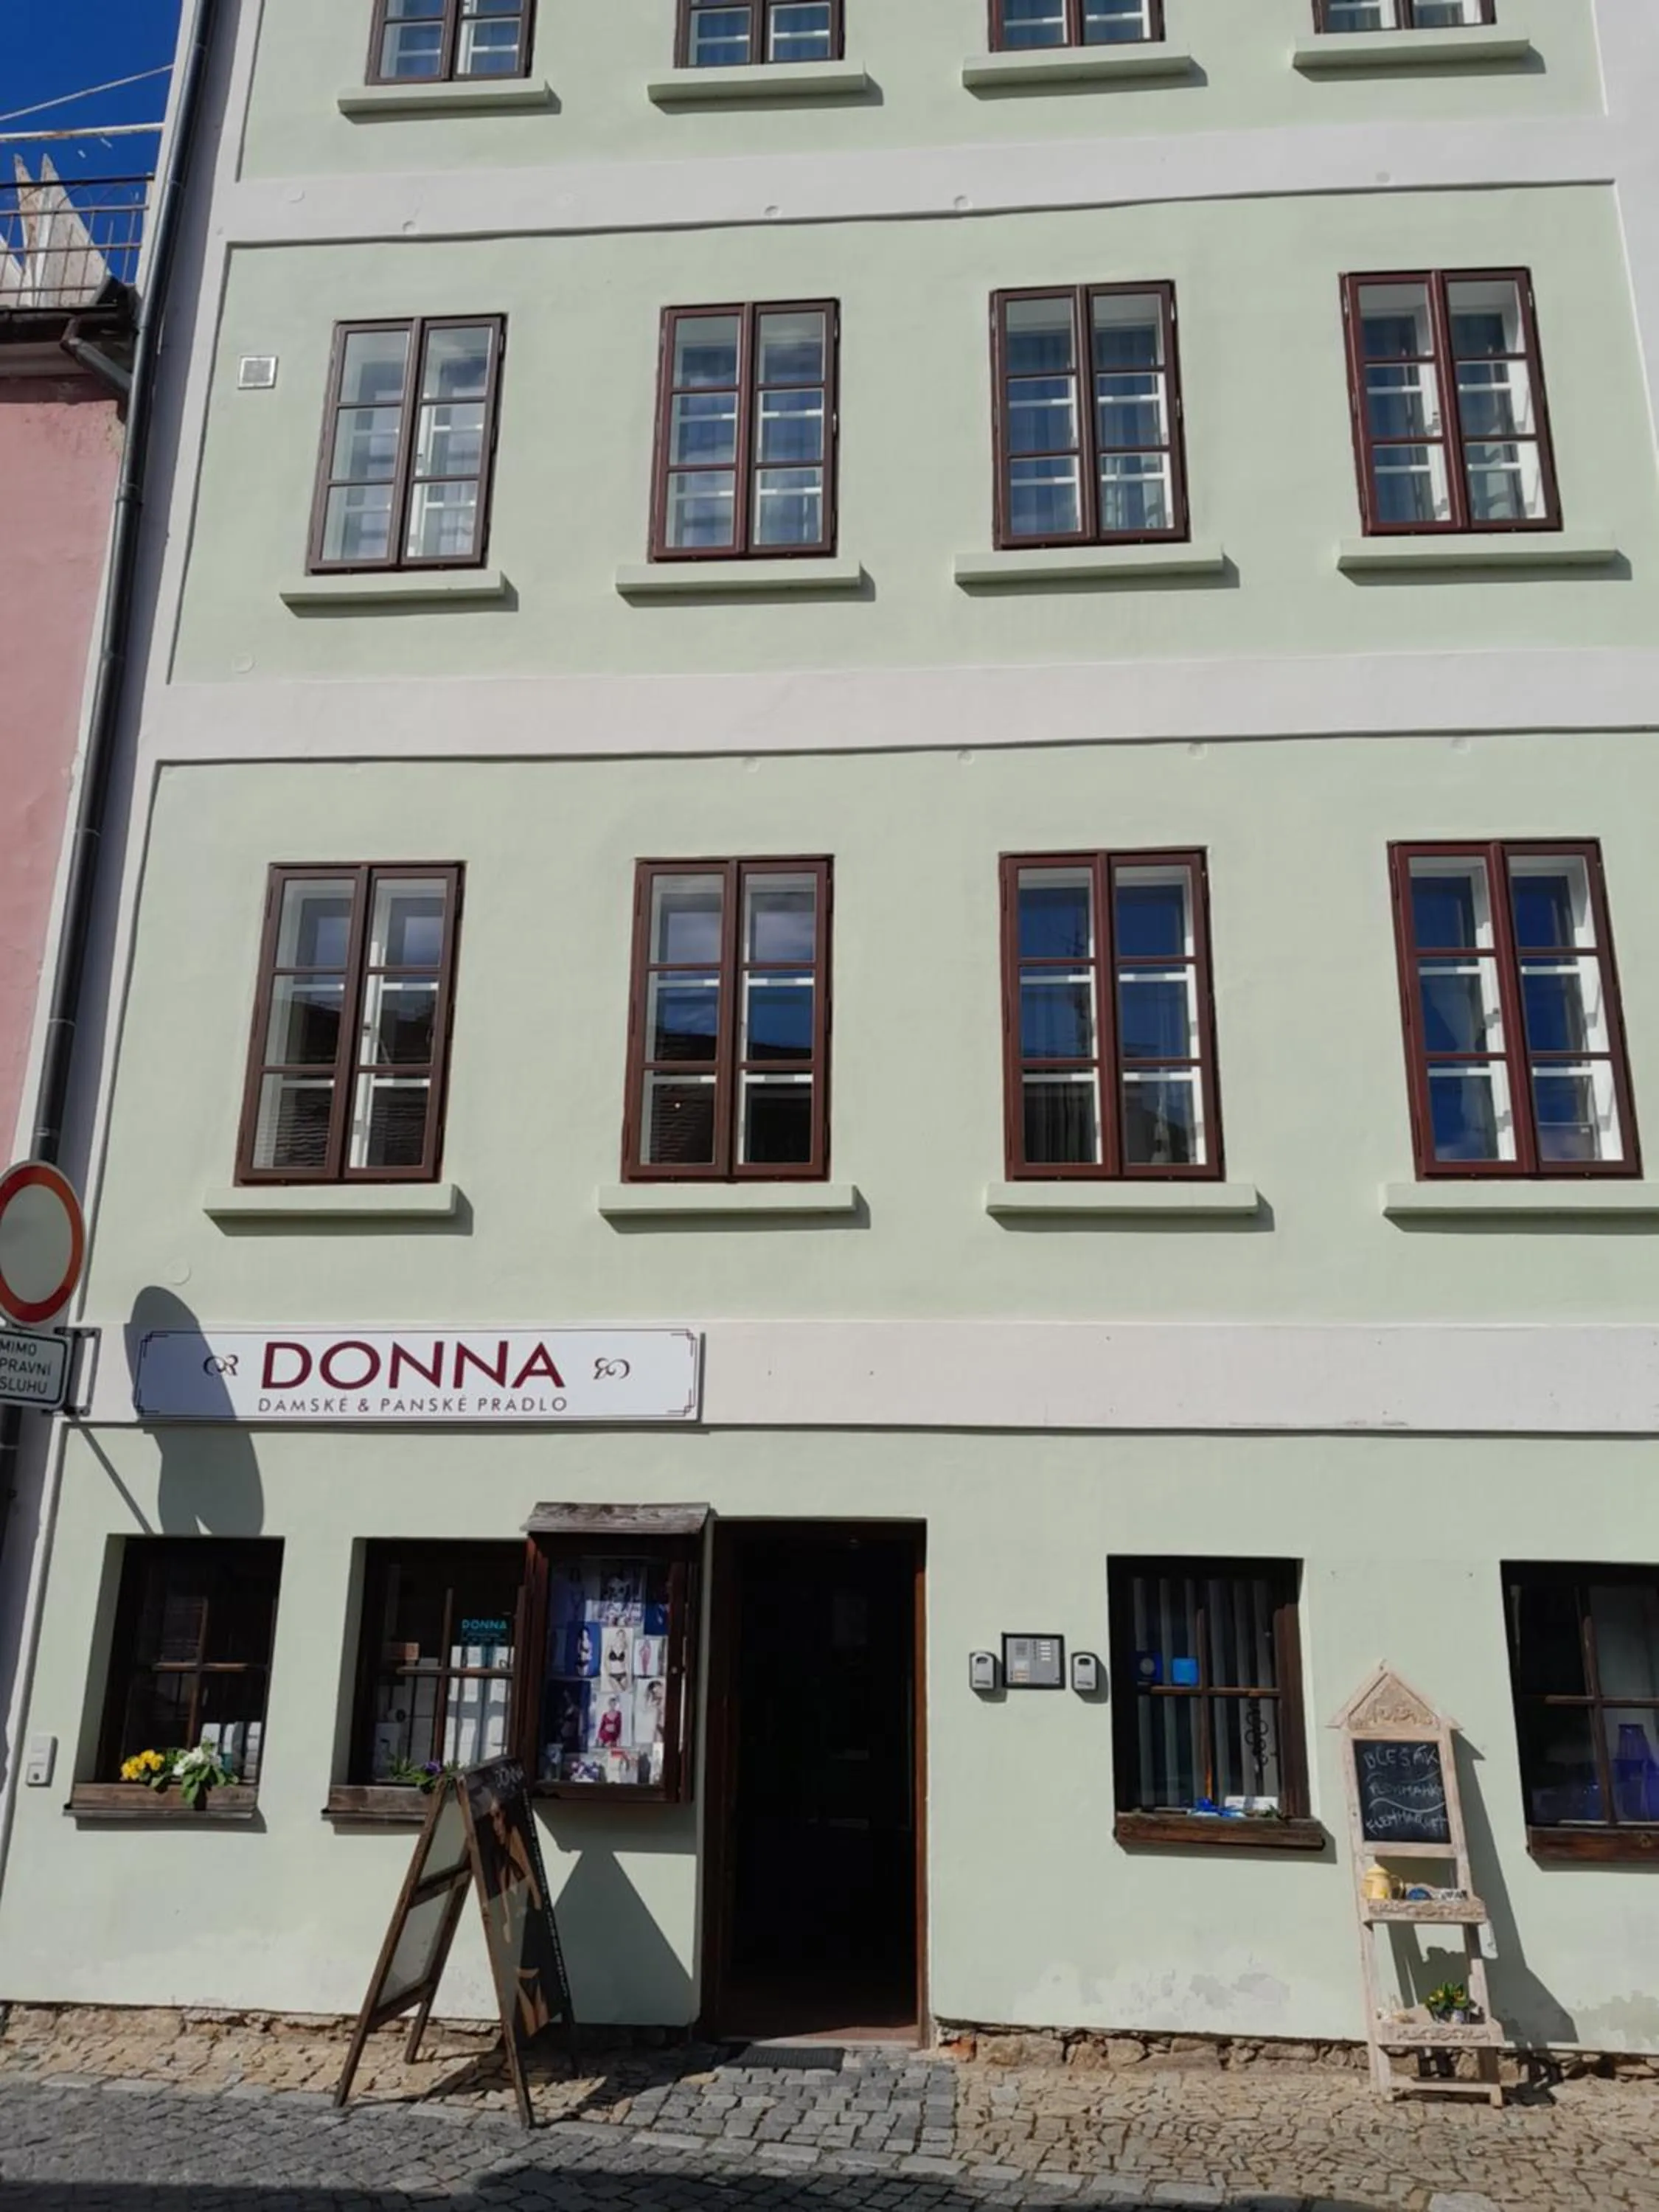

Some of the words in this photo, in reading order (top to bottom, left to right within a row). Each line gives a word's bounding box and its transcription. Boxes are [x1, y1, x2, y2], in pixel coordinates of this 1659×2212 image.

[0, 1338, 37, 1357] MIMO
[262, 1340, 566, 1389] DONNA
[358, 1398, 369, 1412] &
[462, 1618, 507, 1629] DONNA
